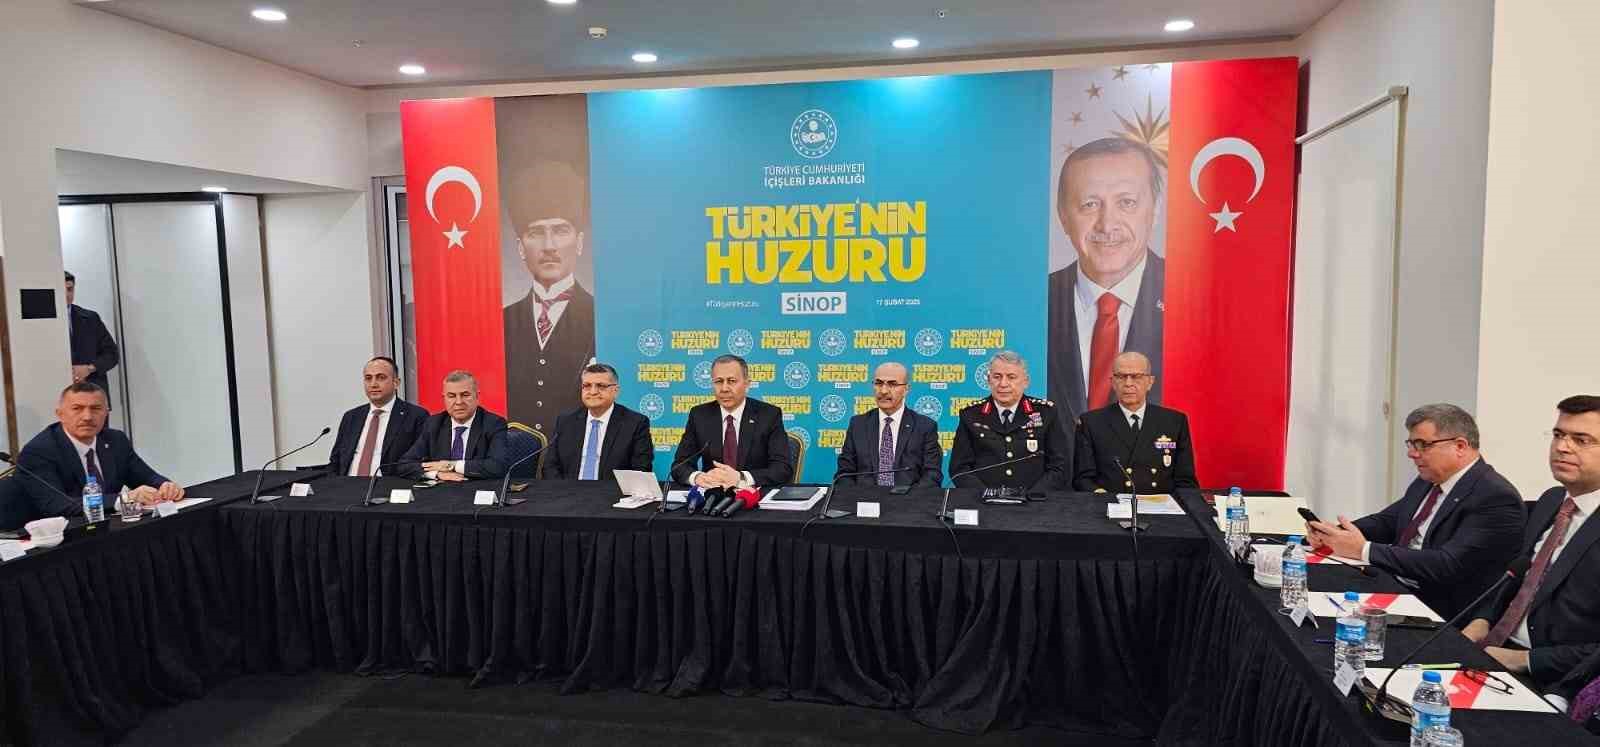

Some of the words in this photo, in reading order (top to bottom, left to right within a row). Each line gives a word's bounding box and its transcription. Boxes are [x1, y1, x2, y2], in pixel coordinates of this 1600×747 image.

[764, 164, 800, 176] TÜRKİYE
[802, 161, 864, 174] CUMHURİYETİ
[764, 175, 805, 189] İÇİŞLERİ
[808, 173, 864, 185] BAKANLIĞI
[705, 196, 926, 239] TÜRKİYE'NİN
[705, 237, 926, 284] HUZURU
[785, 293, 842, 312] SİNOP
